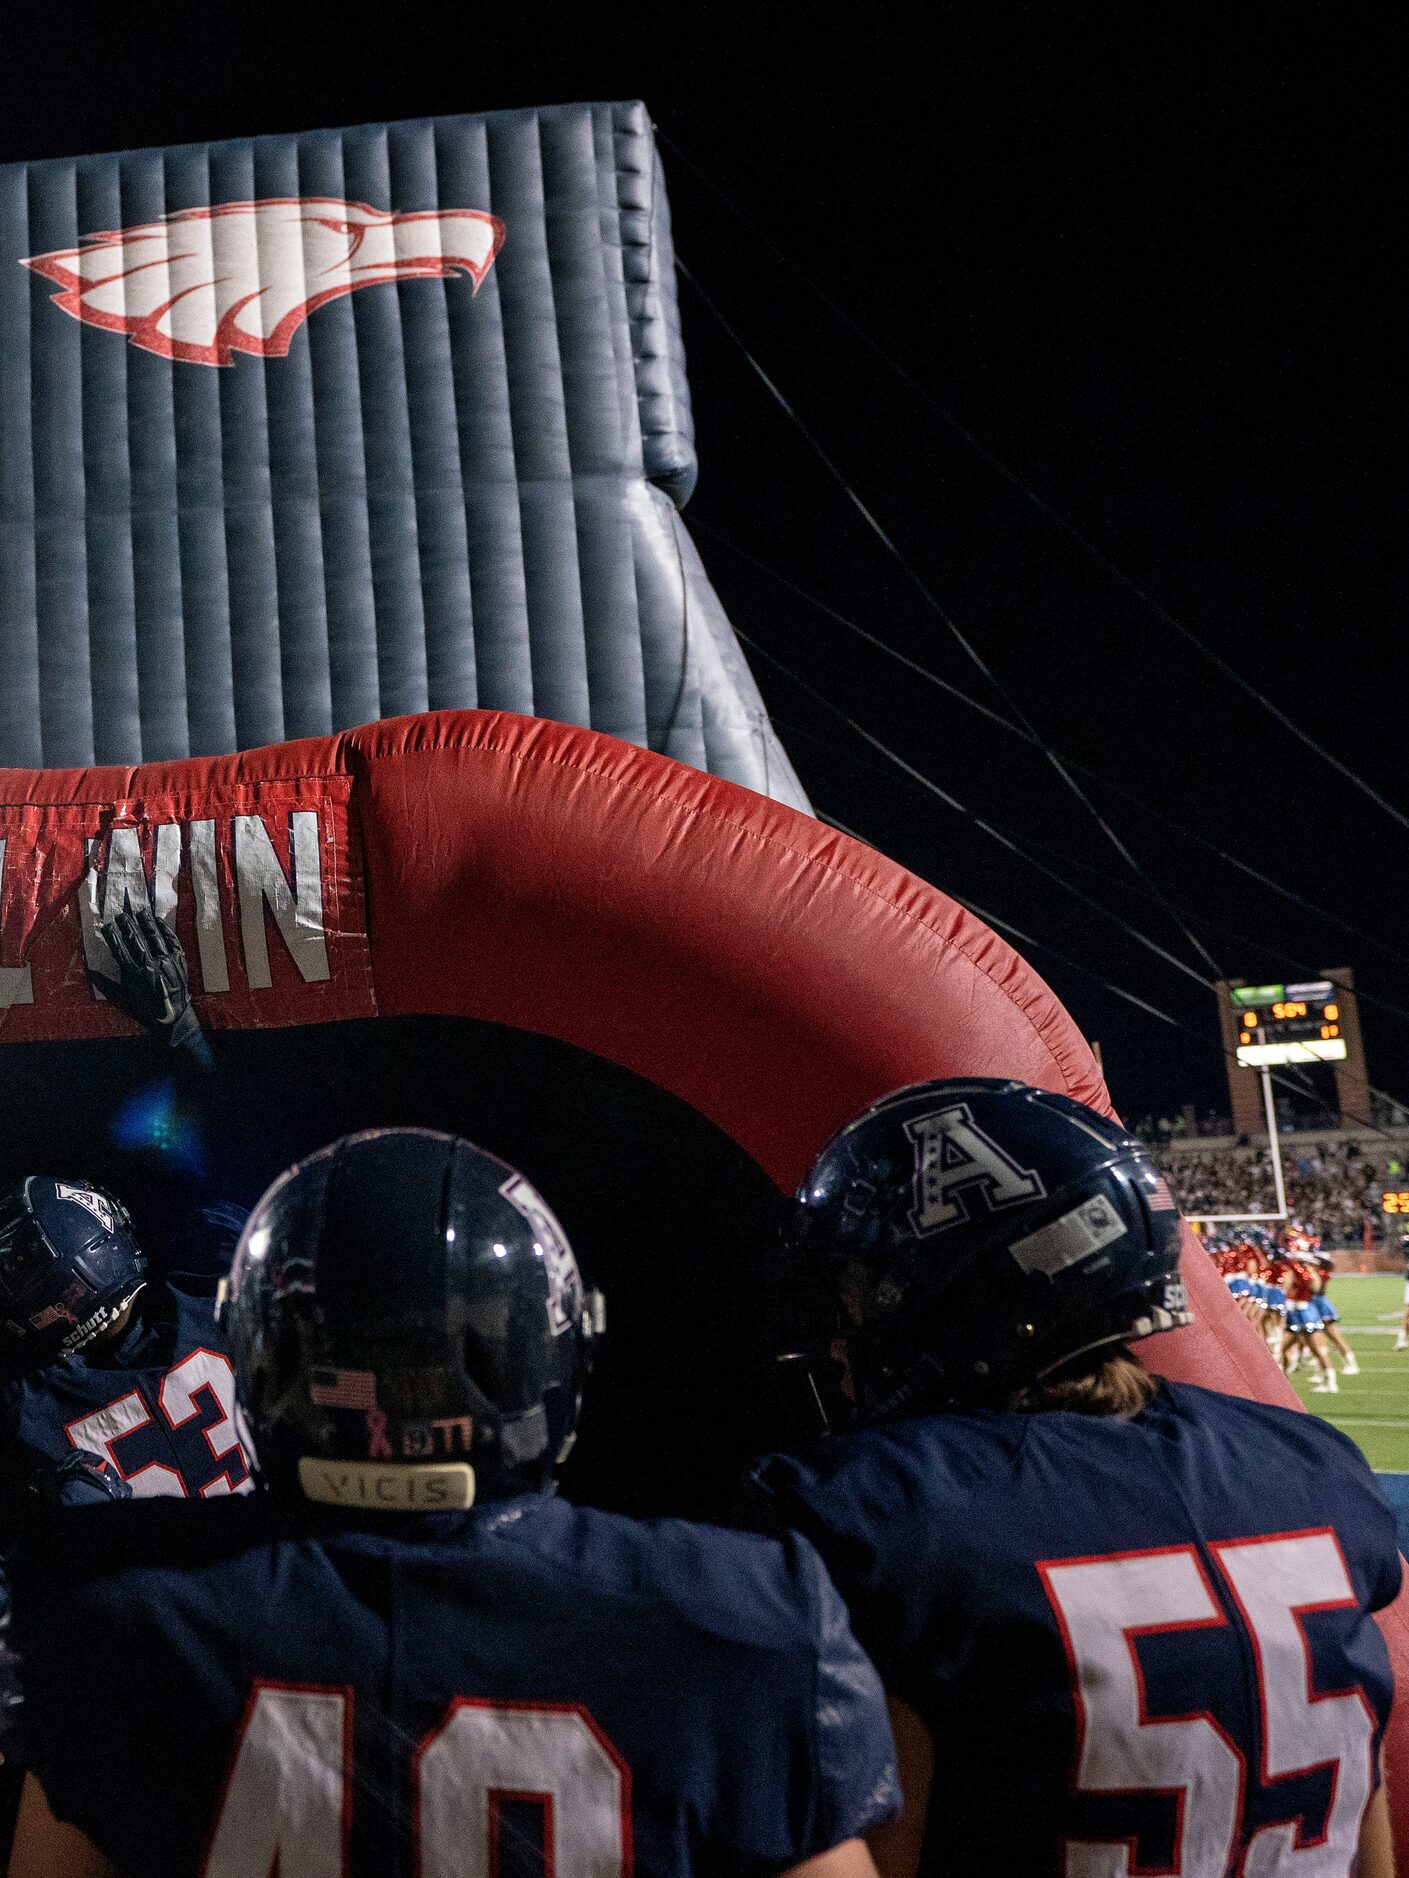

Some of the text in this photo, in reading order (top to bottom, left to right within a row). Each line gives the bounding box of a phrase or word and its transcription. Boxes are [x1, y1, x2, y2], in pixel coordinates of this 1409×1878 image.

[79, 810, 331, 994] WIN
[903, 1102, 1047, 1239] A
[62, 1305, 108, 1347] schutt
[64, 1346, 257, 1498] 53
[322, 1470, 449, 1504] VICIS
[1035, 1525, 1380, 1878] 55
